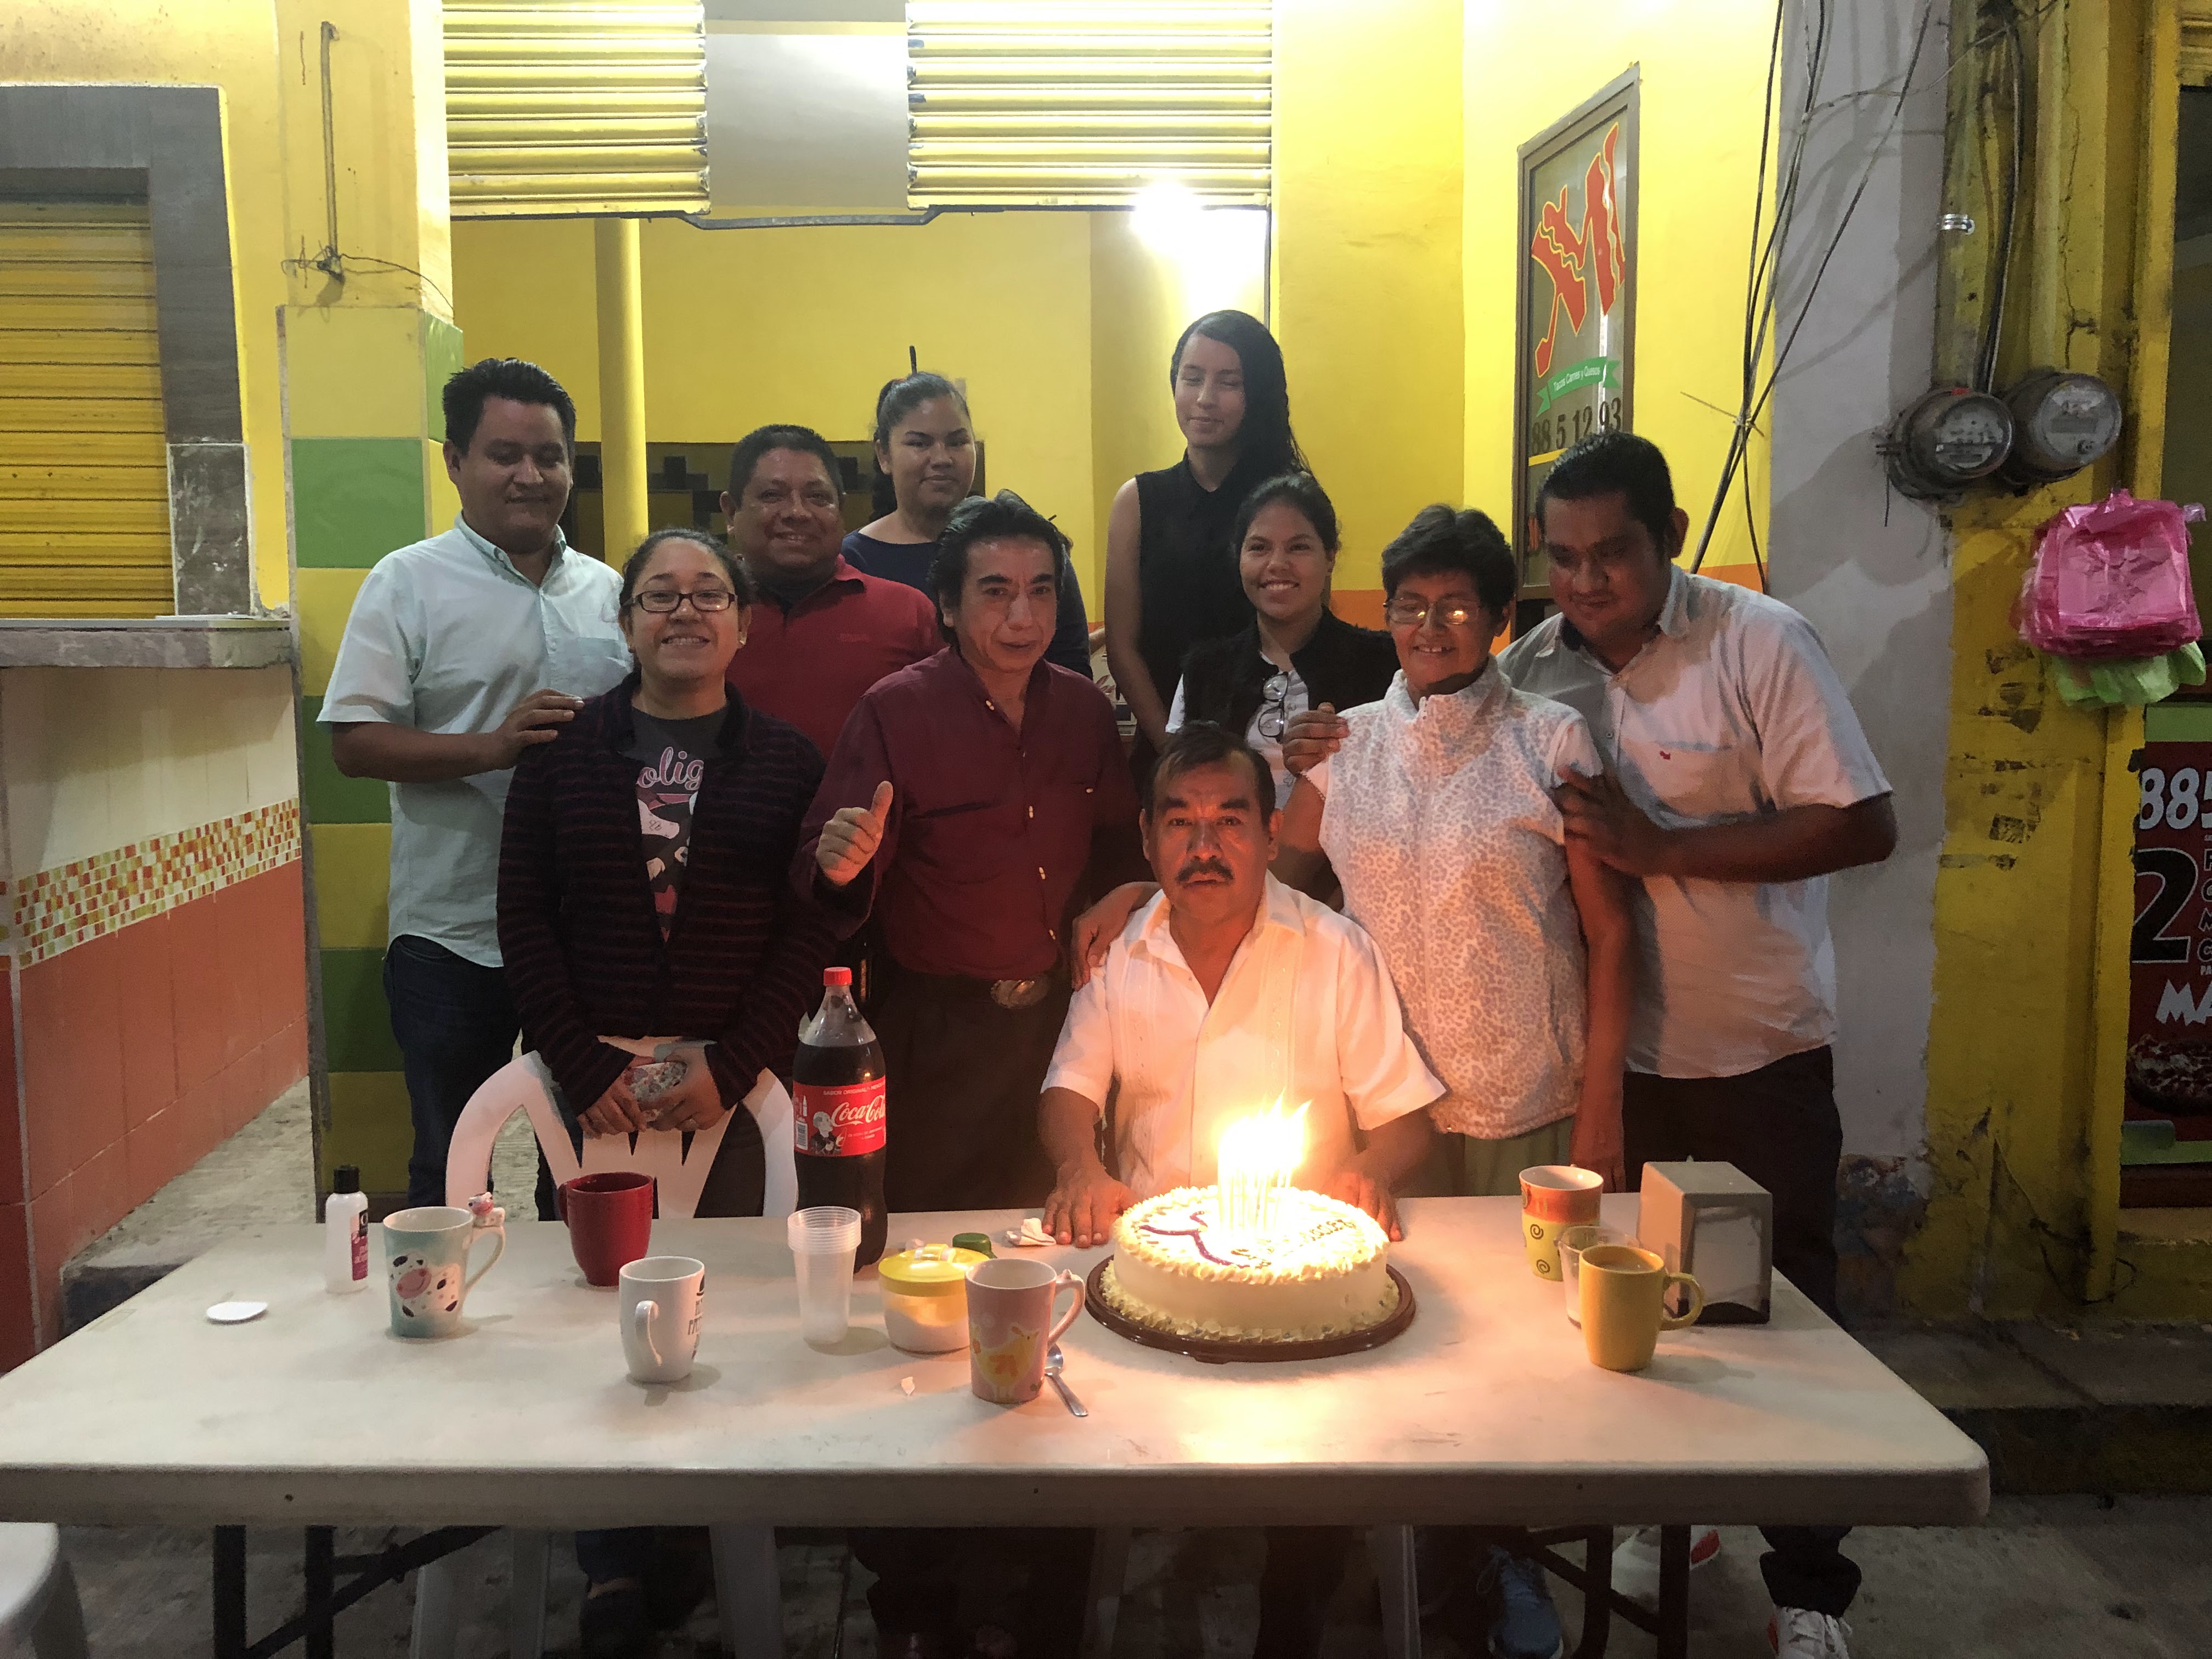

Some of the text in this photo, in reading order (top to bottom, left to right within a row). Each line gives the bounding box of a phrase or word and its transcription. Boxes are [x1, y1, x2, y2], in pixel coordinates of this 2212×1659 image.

[1554, 378, 1565, 391] Tacos
[1566, 371, 1580, 384] Carnes
[1584, 366, 1600, 377] Quesos
[1556, 414, 1566, 449] 5
[1573, 406, 1592, 442] 12
[2132, 848, 2198, 963] 2
